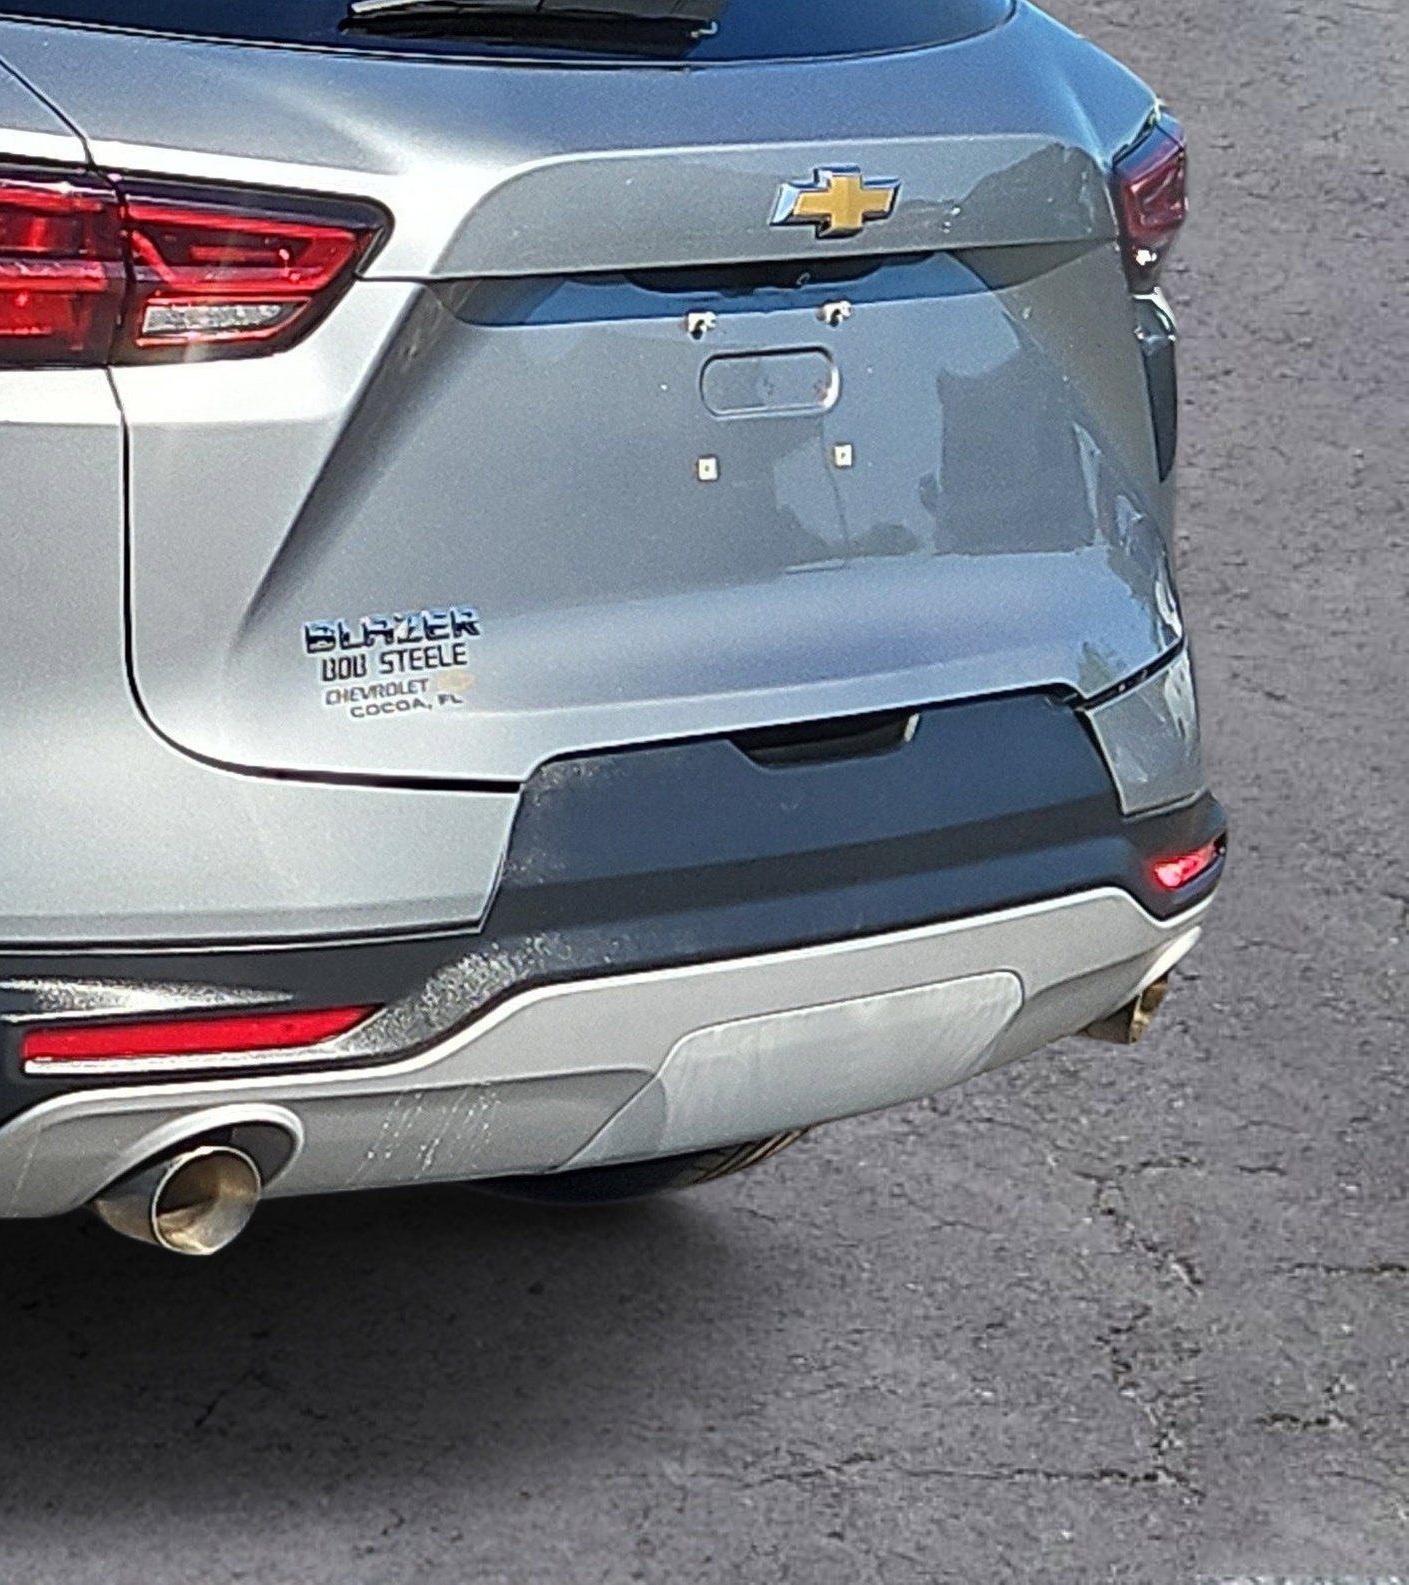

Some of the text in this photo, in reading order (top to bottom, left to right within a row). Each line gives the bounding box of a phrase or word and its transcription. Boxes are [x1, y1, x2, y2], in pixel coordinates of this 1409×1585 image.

[303, 607, 482, 654] BLAZER
[321, 642, 468, 682] BOB STEELE
[325, 677, 430, 706] CHEVROLET
[349, 693, 464, 718] COCOA, FL
